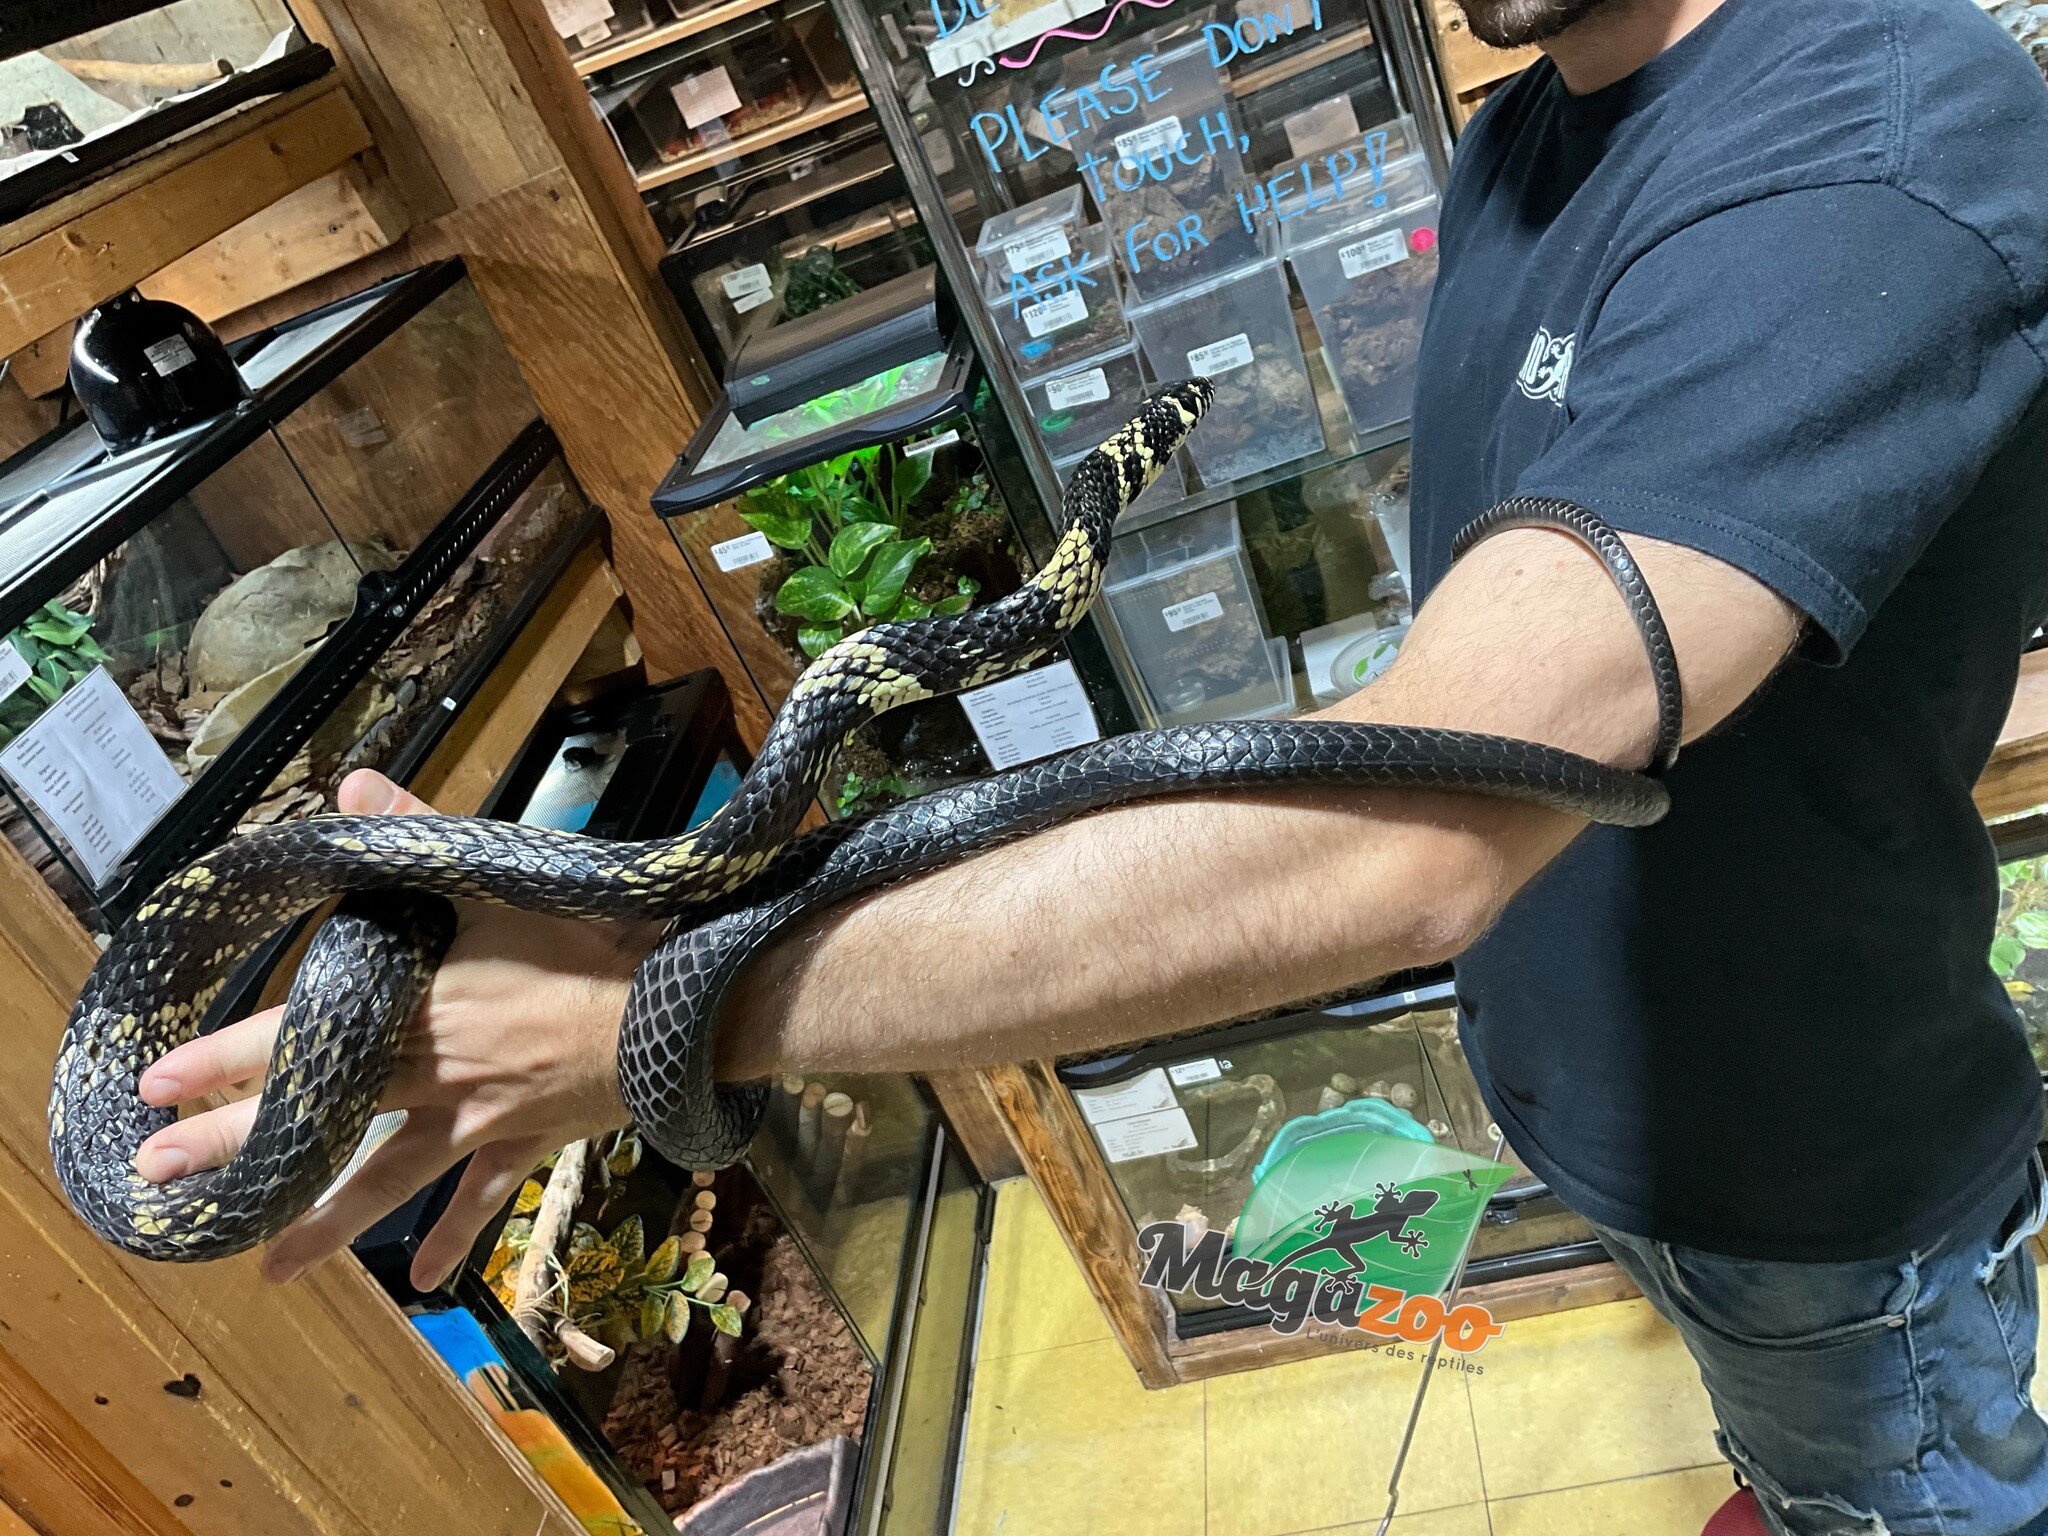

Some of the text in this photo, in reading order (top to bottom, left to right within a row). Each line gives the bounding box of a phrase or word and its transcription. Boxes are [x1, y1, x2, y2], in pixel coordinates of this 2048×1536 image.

[970, 53, 1174, 173] PLEASE
[1010, 130, 1388, 320] ASK FOR HELP!
